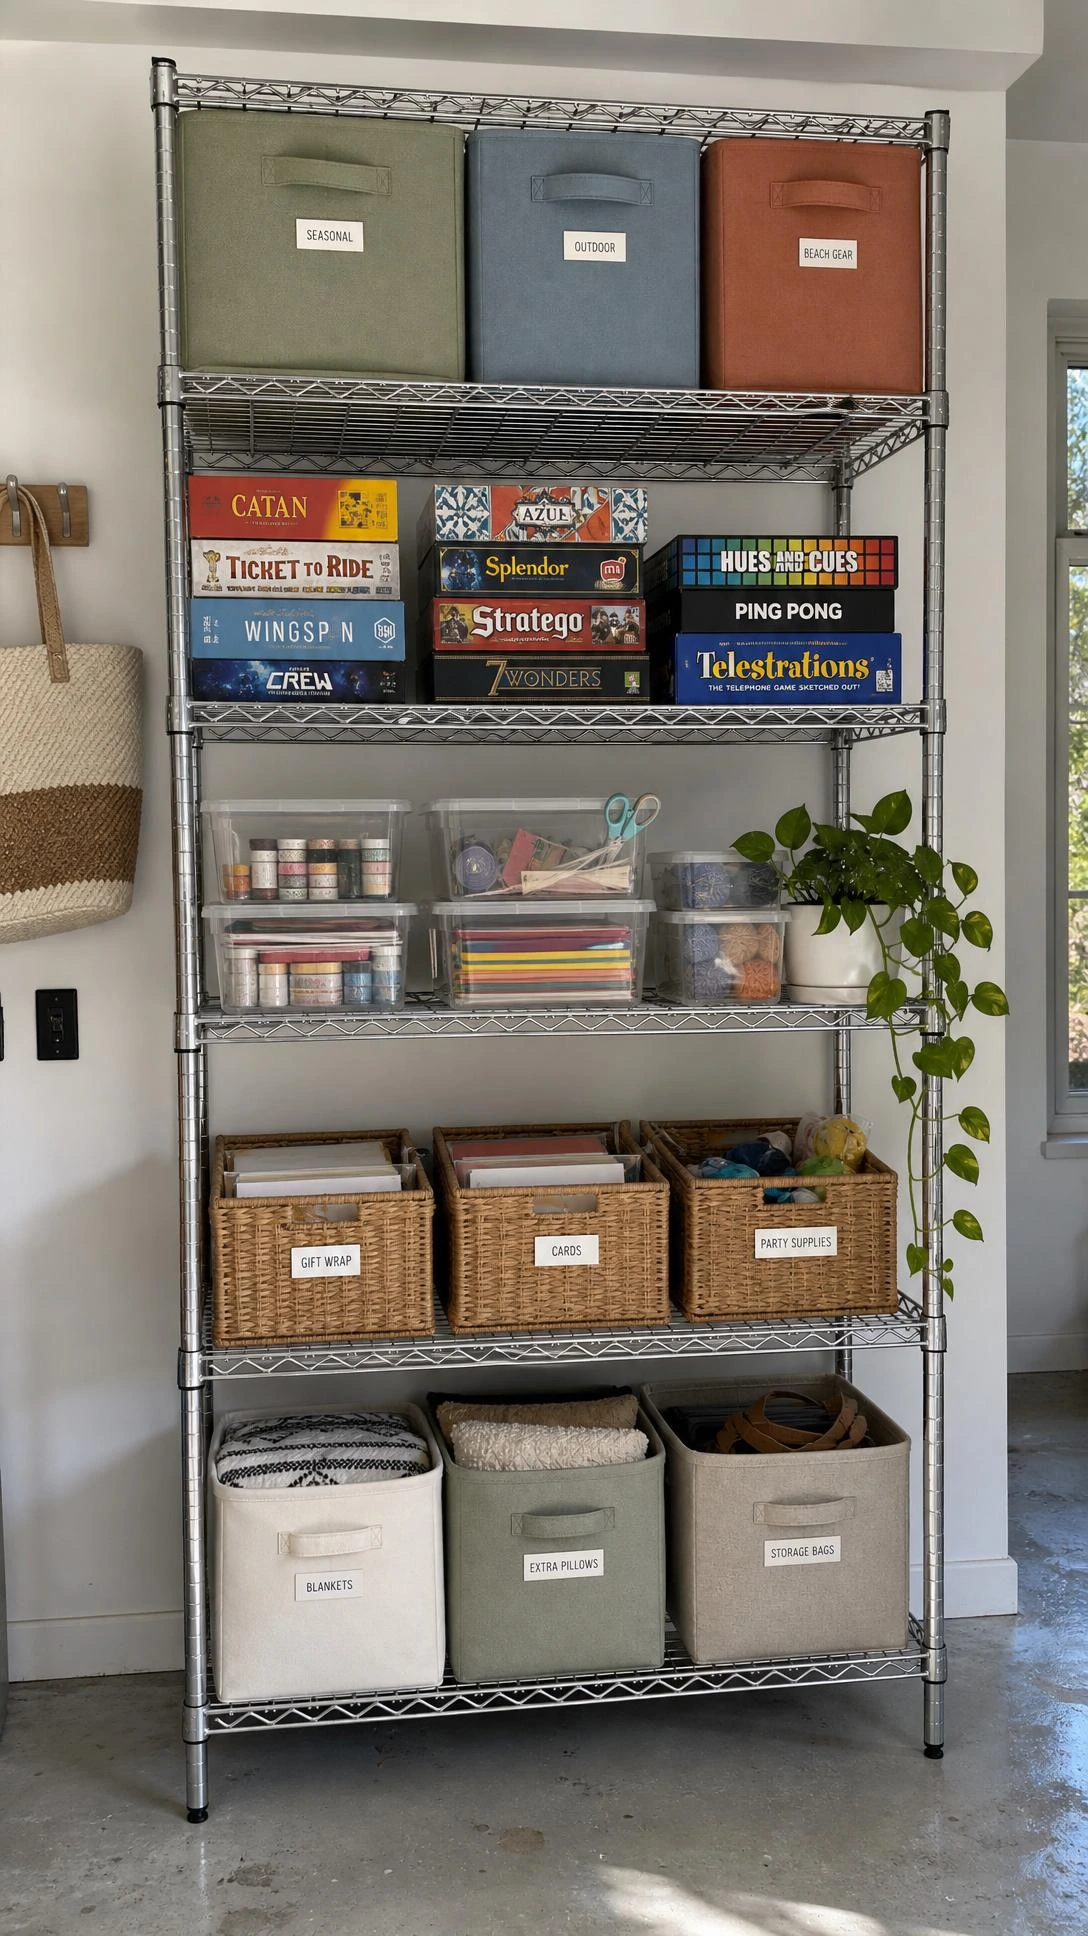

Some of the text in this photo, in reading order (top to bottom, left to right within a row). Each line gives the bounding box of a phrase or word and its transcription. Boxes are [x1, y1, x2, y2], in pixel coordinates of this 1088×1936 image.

[306, 229, 353, 242] SEASONAL
[574, 241, 616, 253] OUTDOOR
[804, 247, 853, 260] BEACH GEAR
[231, 494, 308, 518] CATAN
[226, 555, 300, 580] TICKET
[304, 562, 323, 576] TO
[327, 554, 374, 579] RIDE
[485, 555, 569, 583] Splendor
[720, 550, 771, 573] HUES
[808, 550, 858, 573] CUES
[735, 602, 843, 620] PING PONG
[245, 620, 353, 643] WINGSPN
[470, 605, 584, 640] Stratego
[696, 650, 870, 680] Telestrations
[266, 672, 334, 691] CREW
[486, 659, 602, 696] 7 WONDERS
[551, 1245, 582, 1257] CARDS
[760, 1236, 832, 1249] PARTY SUPPLIES
[301, 1255, 352, 1268] GIFT WRAP
[771, 1544, 835, 1559] STORAGE BAGS
[529, 1558, 599, 1573] EXTRA PILLOWS
[306, 1579, 353, 1593] BLANKETS
